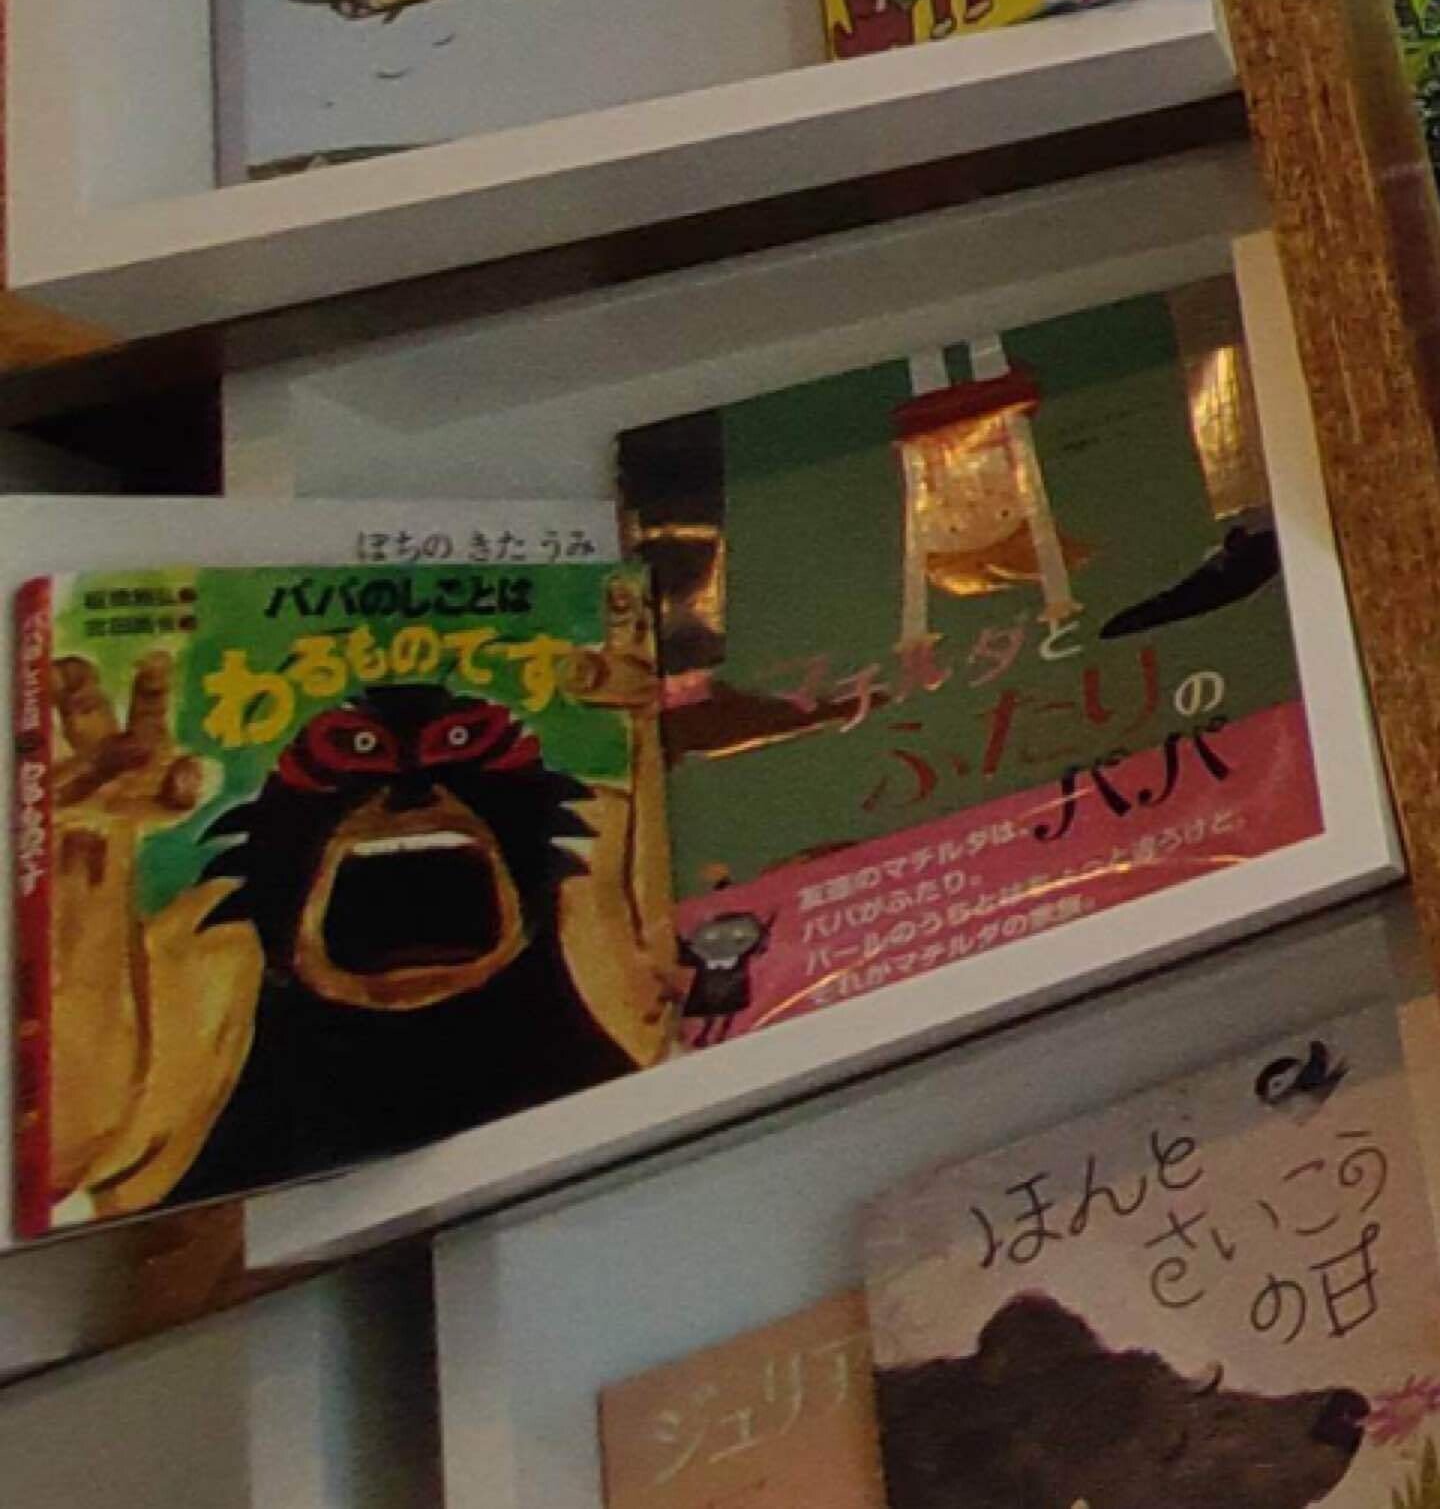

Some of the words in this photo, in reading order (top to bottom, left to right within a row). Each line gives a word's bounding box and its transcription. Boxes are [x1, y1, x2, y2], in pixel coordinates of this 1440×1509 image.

[467, 530, 527, 562] きた
[540, 530, 596, 562] うみ
[202, 624, 576, 749] わるものです
[755, 617, 1082, 733] マチルダと
[862, 646, 1225, 812] ふたりの
[1033, 713, 1232, 840] パパ
[967, 1129, 1204, 1272] ほんと
[1141, 1128, 1389, 1310] さいこう
[1248, 1221, 1382, 1346] の日
[648, 1330, 874, 1488] ジュリア
